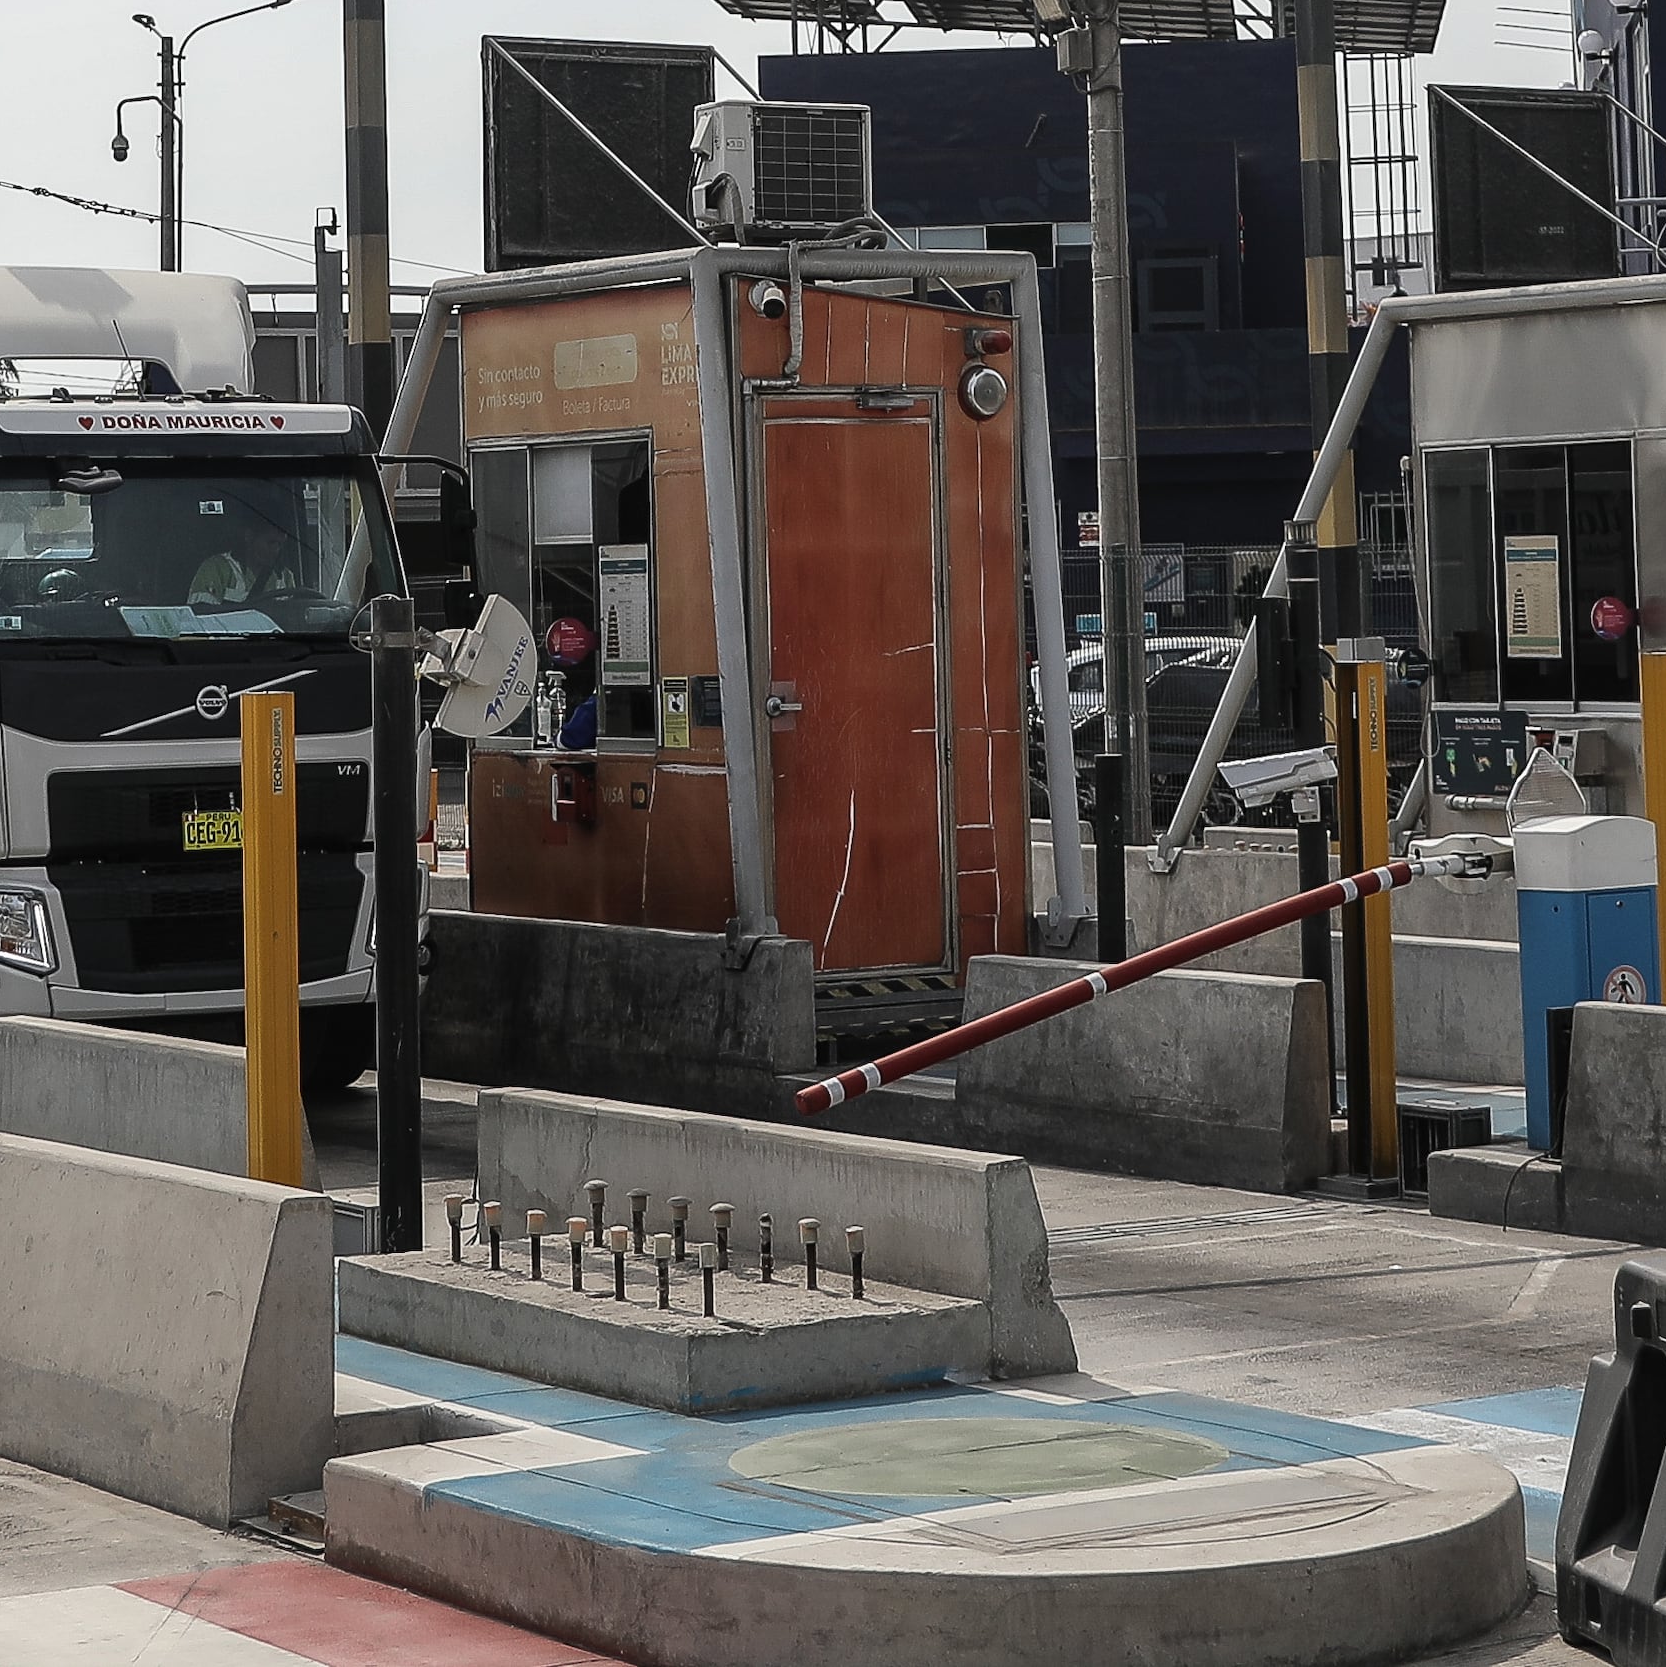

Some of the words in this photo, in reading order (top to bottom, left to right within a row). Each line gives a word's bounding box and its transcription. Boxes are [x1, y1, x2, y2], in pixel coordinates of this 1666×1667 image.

[478, 367, 493, 384] Sin
[494, 365, 541, 383] contacto
[660, 365, 697, 385] EXPR
[478, 396, 486, 413] y
[486, 392, 508, 408] más
[508, 390, 543, 409] seguro
[562, 397, 591, 415] Boleta
[597, 396, 631, 413] Factura
[101, 412, 162, 430] DOÑA
[166, 415, 266, 430] MAURICIA
[496, 636, 529, 696] VANJEE
[199, 698, 227, 707] VOLVO
[273, 709, 282, 794] TECHNOSUPPLY
[337, 764, 361, 775] VM
[600, 786, 625, 803] VISA
[206, 813, 231, 822] PERU
[186, 820, 242, 845] CEG-91
